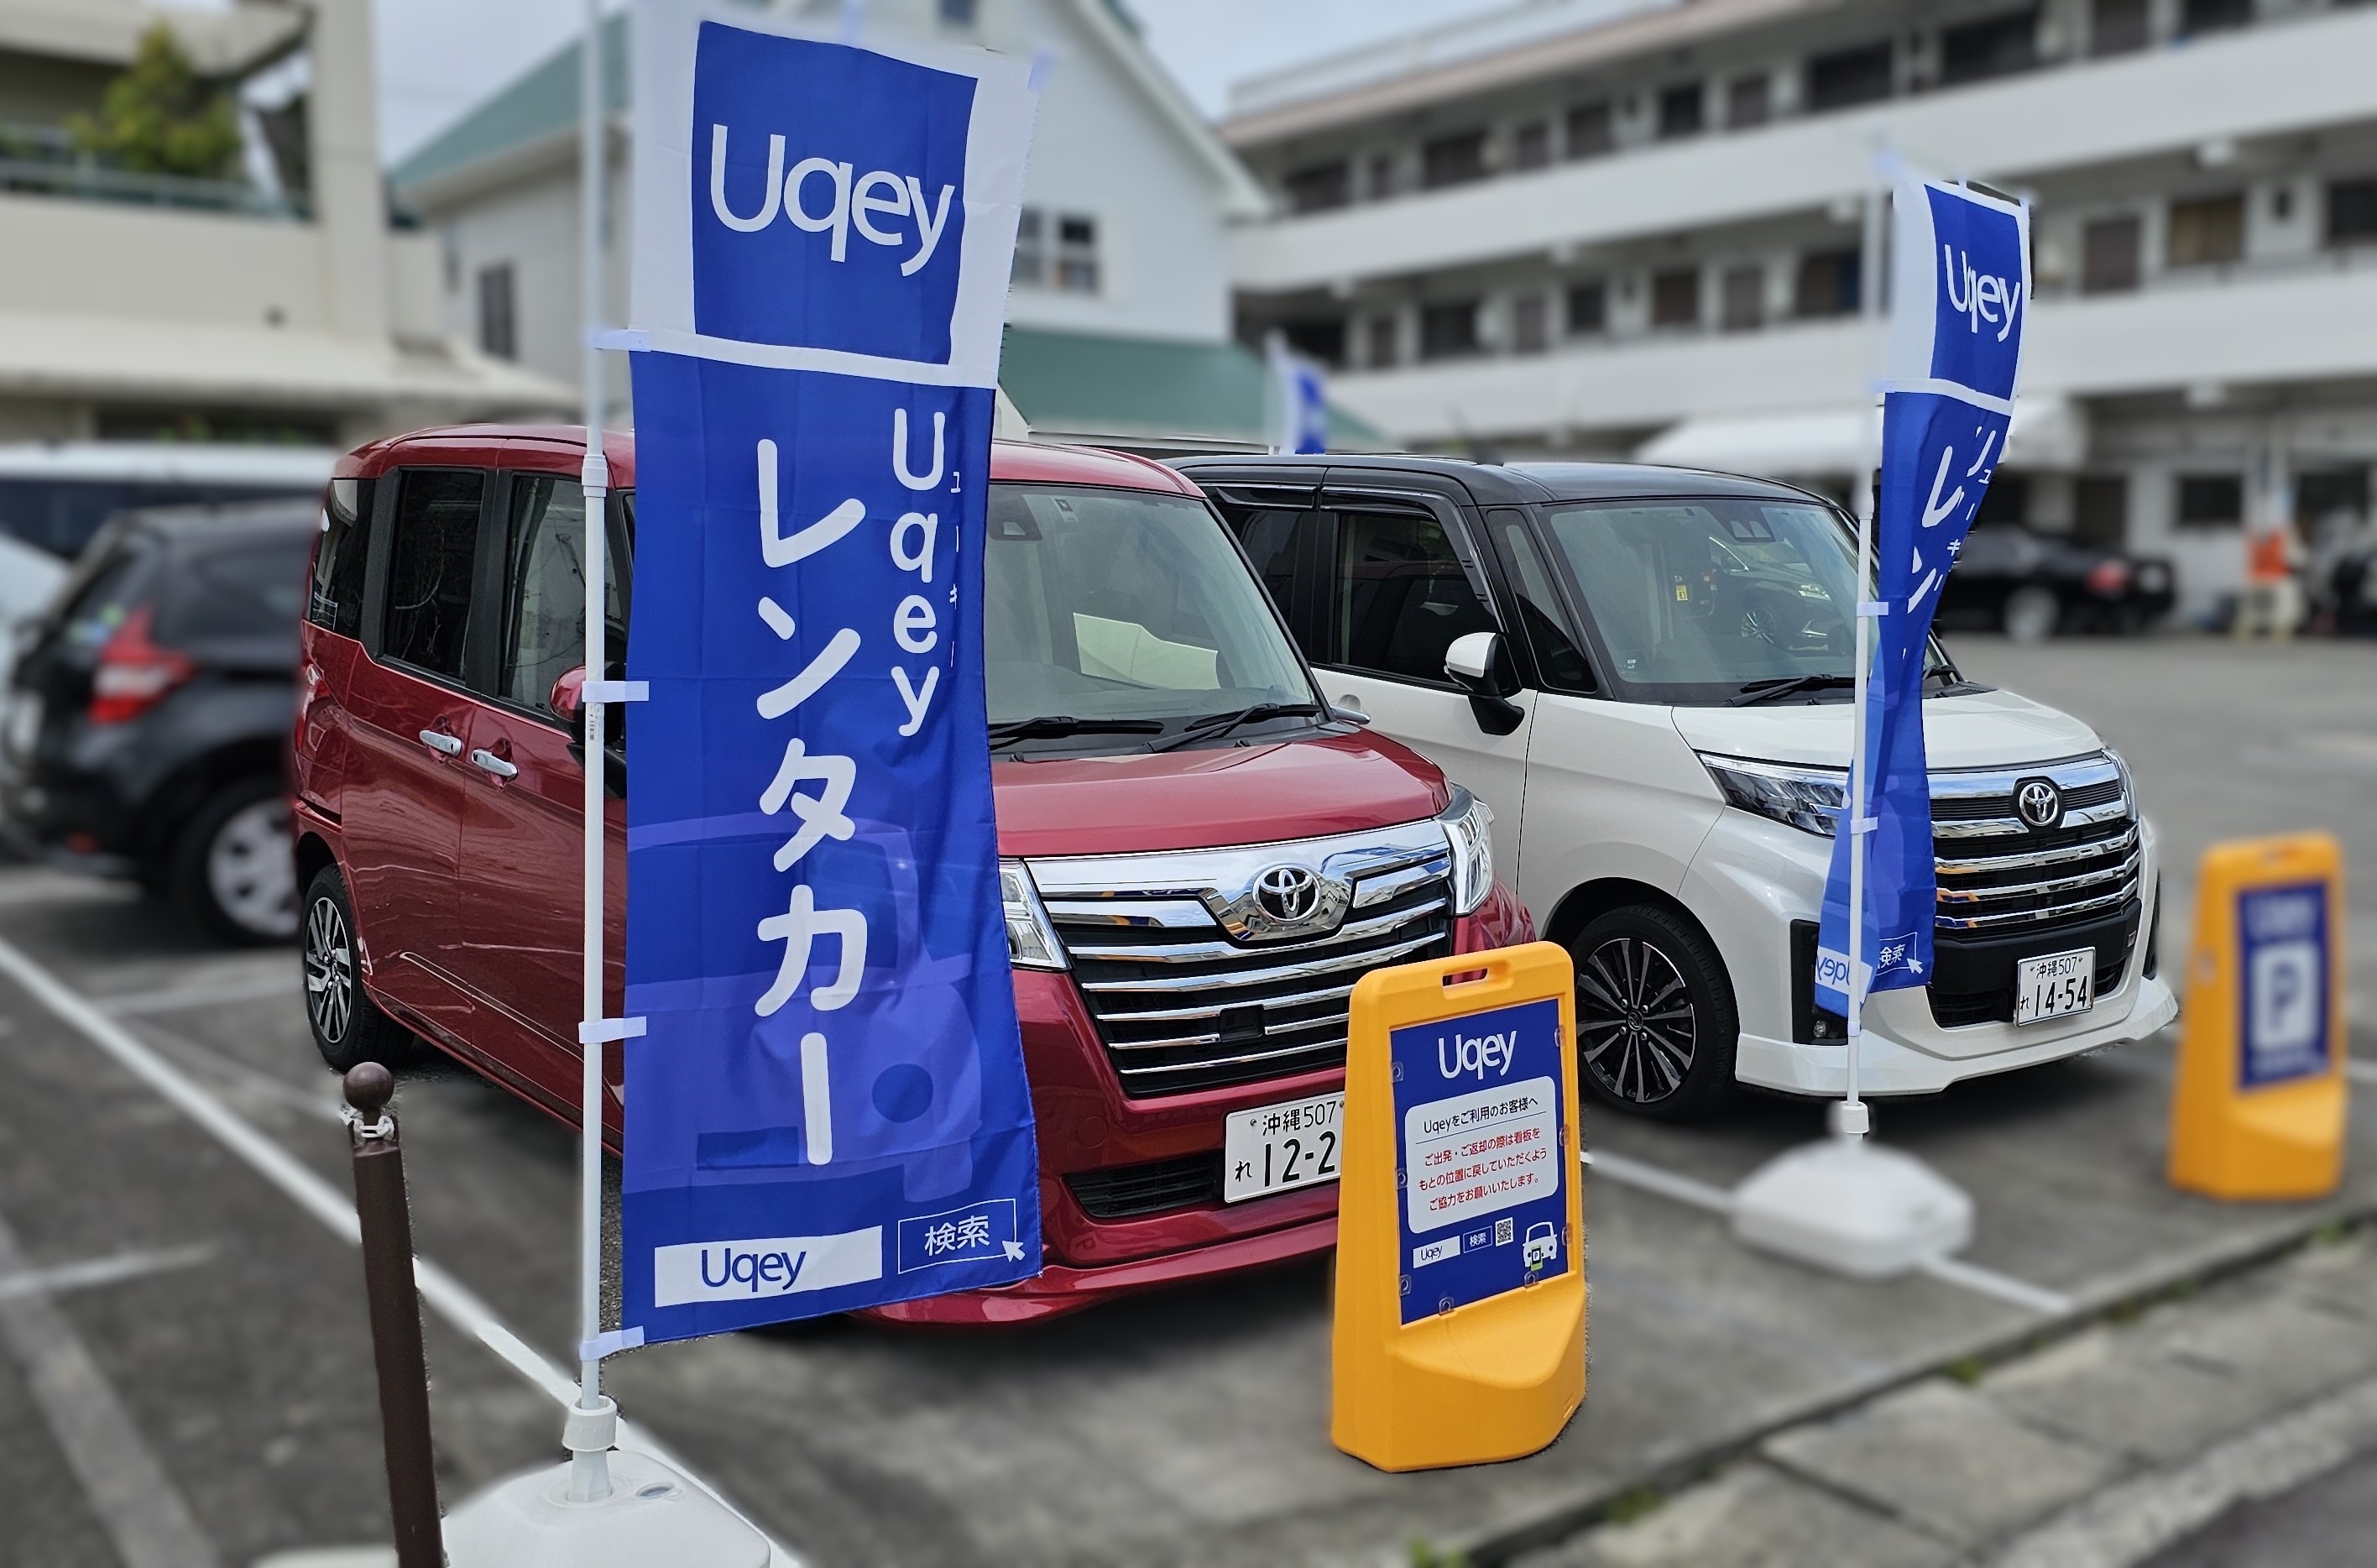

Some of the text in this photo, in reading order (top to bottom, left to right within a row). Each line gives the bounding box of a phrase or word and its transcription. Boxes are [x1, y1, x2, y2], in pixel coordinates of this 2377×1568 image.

[711, 124, 955, 276] Uqey
[890, 408, 945, 736] Uqey
[755, 439, 867, 1165] レンタカー
[2035, 975, 2087, 1017] 14-54
[1438, 1031, 1518, 1080] Uqey
[1424, 1096, 1539, 1134] Uqeyをご利用のお客様へ
[1236, 1131, 1336, 1187] れ 12-2
[1419, 1147, 1547, 1191] もとの位置に戻していただくよう
[1429, 1173, 1539, 1211] ご協力をお願いいたします。
[924, 1215, 990, 1256] 検索
[1420, 1245, 1443, 1261] Uqey
[1469, 1231, 1486, 1247] 検索
[702, 1248, 806, 1292] Uqey
